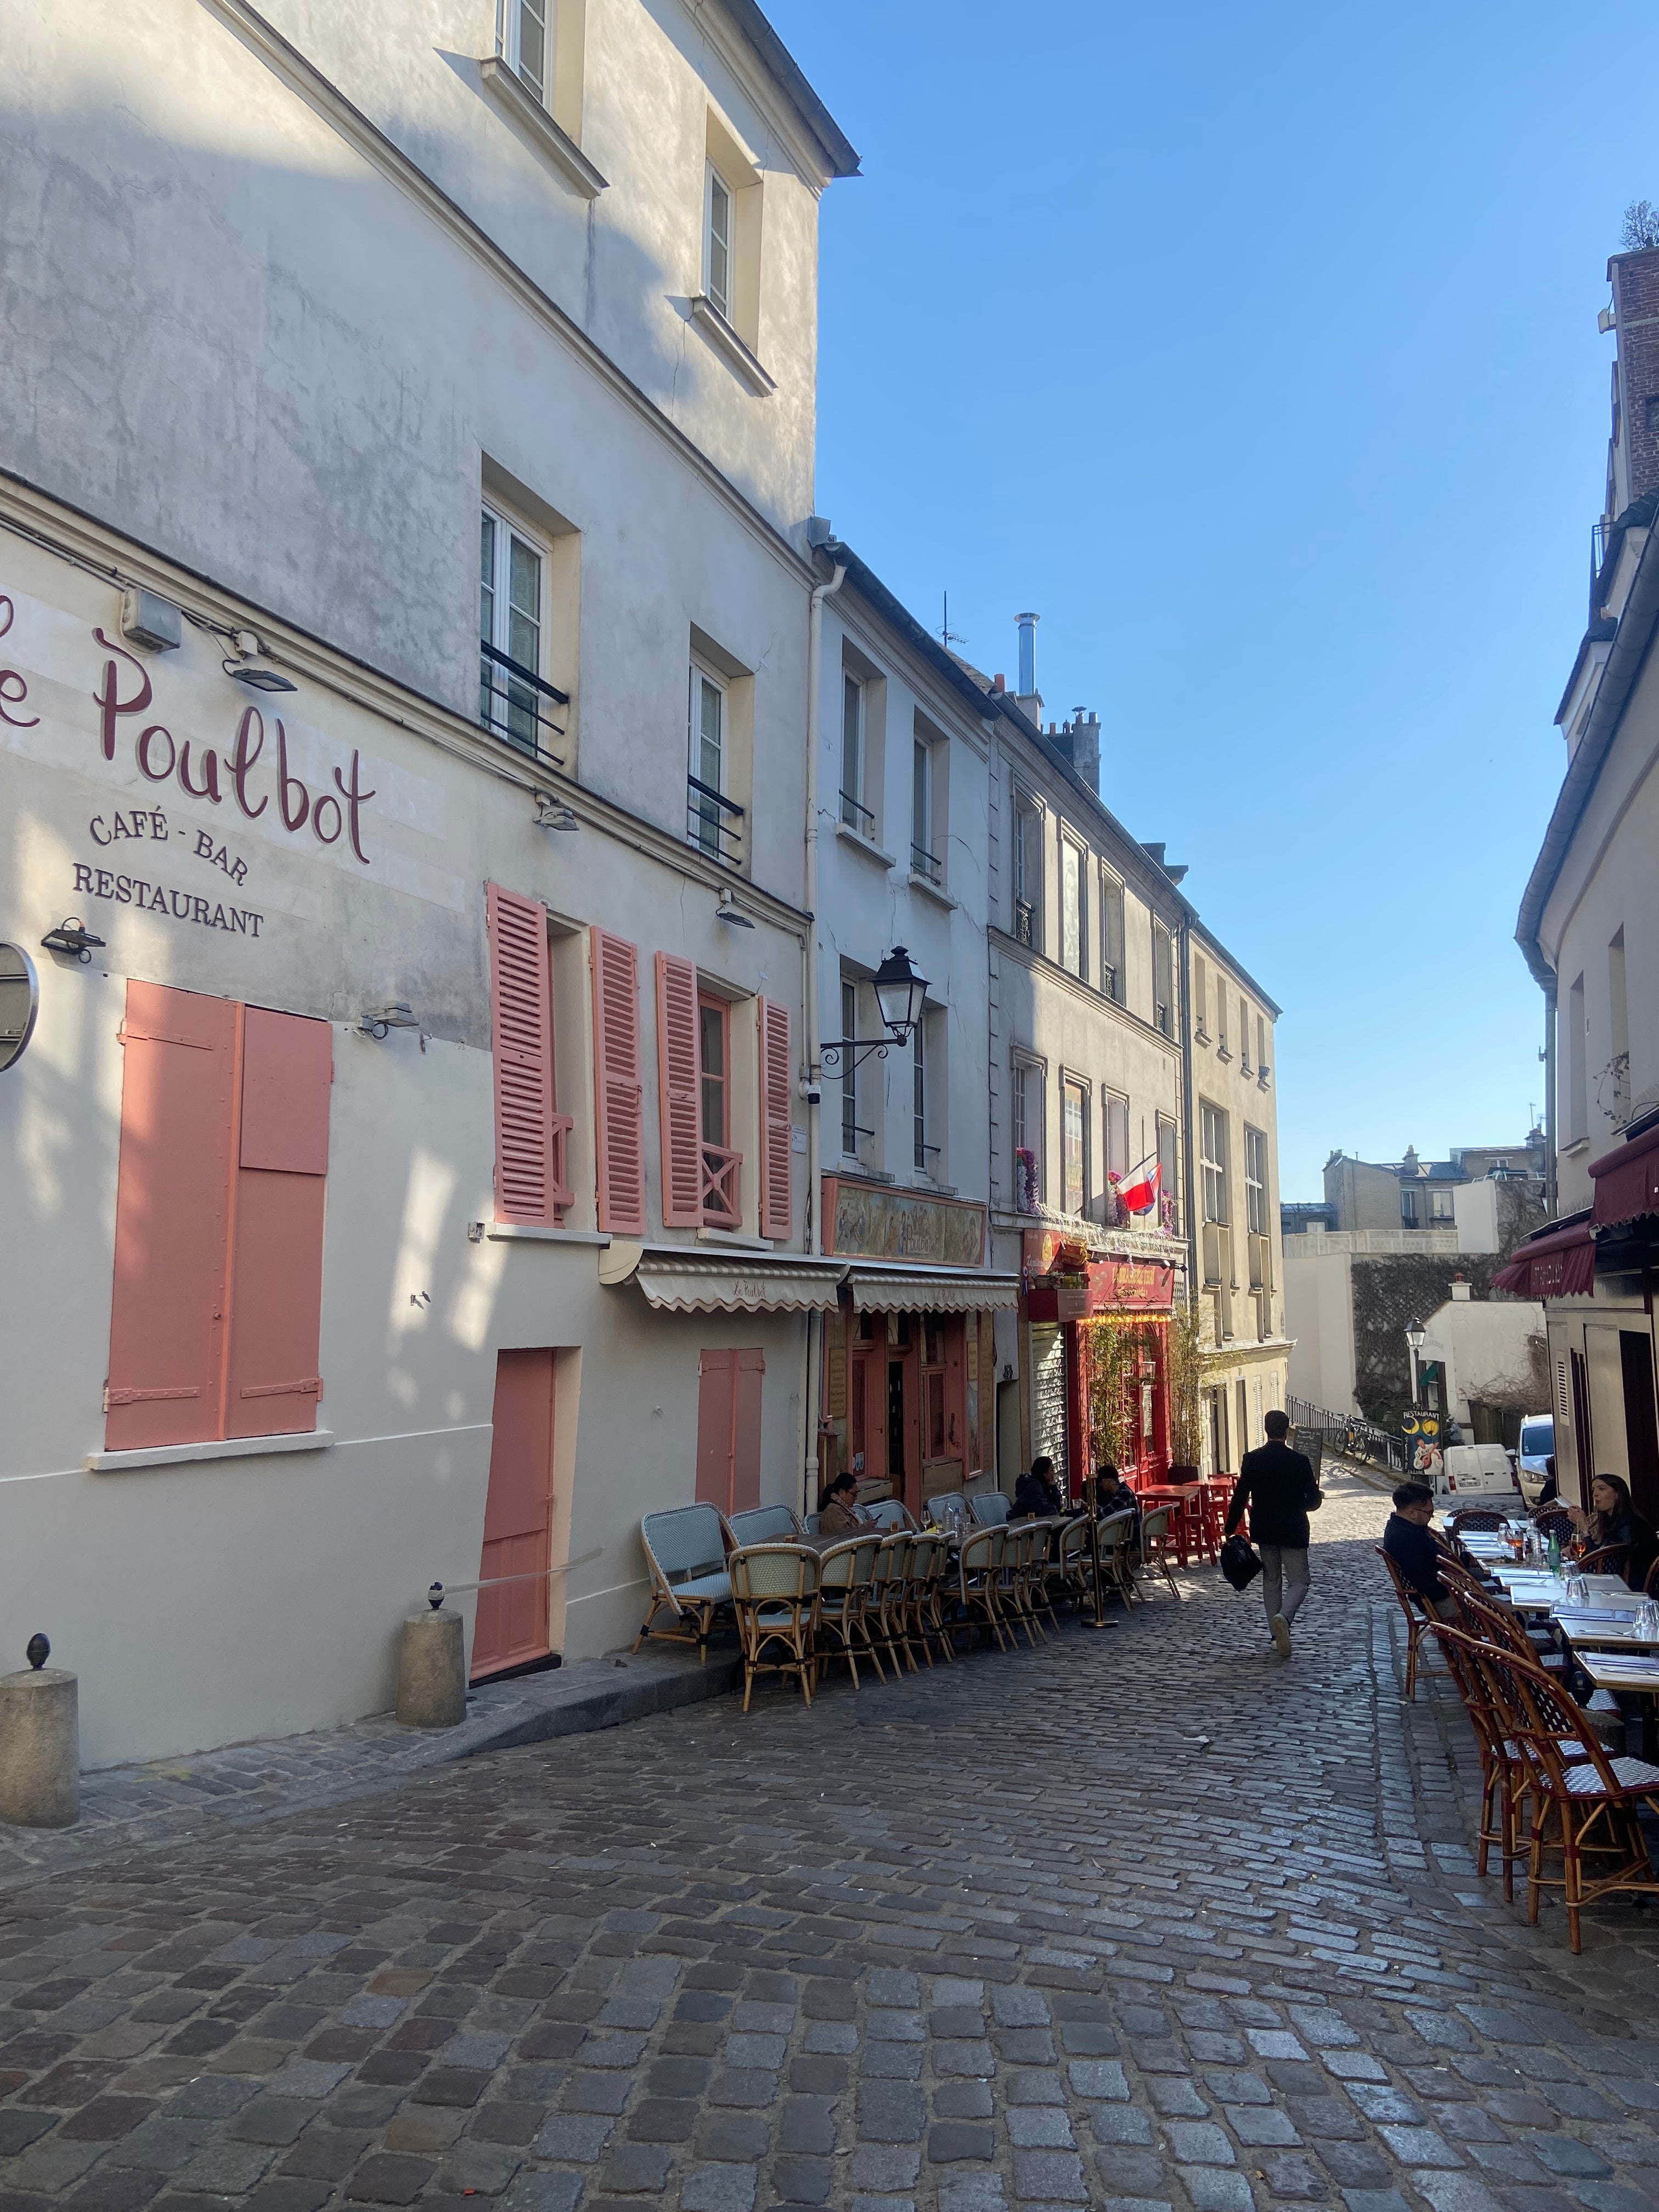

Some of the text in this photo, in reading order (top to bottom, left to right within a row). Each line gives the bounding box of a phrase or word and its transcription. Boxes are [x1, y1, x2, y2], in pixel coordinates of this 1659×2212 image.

[93, 627, 376, 865] Poulbot
[89, 805, 168, 846] CAFÉ
[193, 829, 249, 887] BAR
[72, 862, 264, 938] RESTAURANT
[733, 1279, 766, 1298] Le Poulbot
[1403, 1410, 1440, 1420] RESTAURANT
